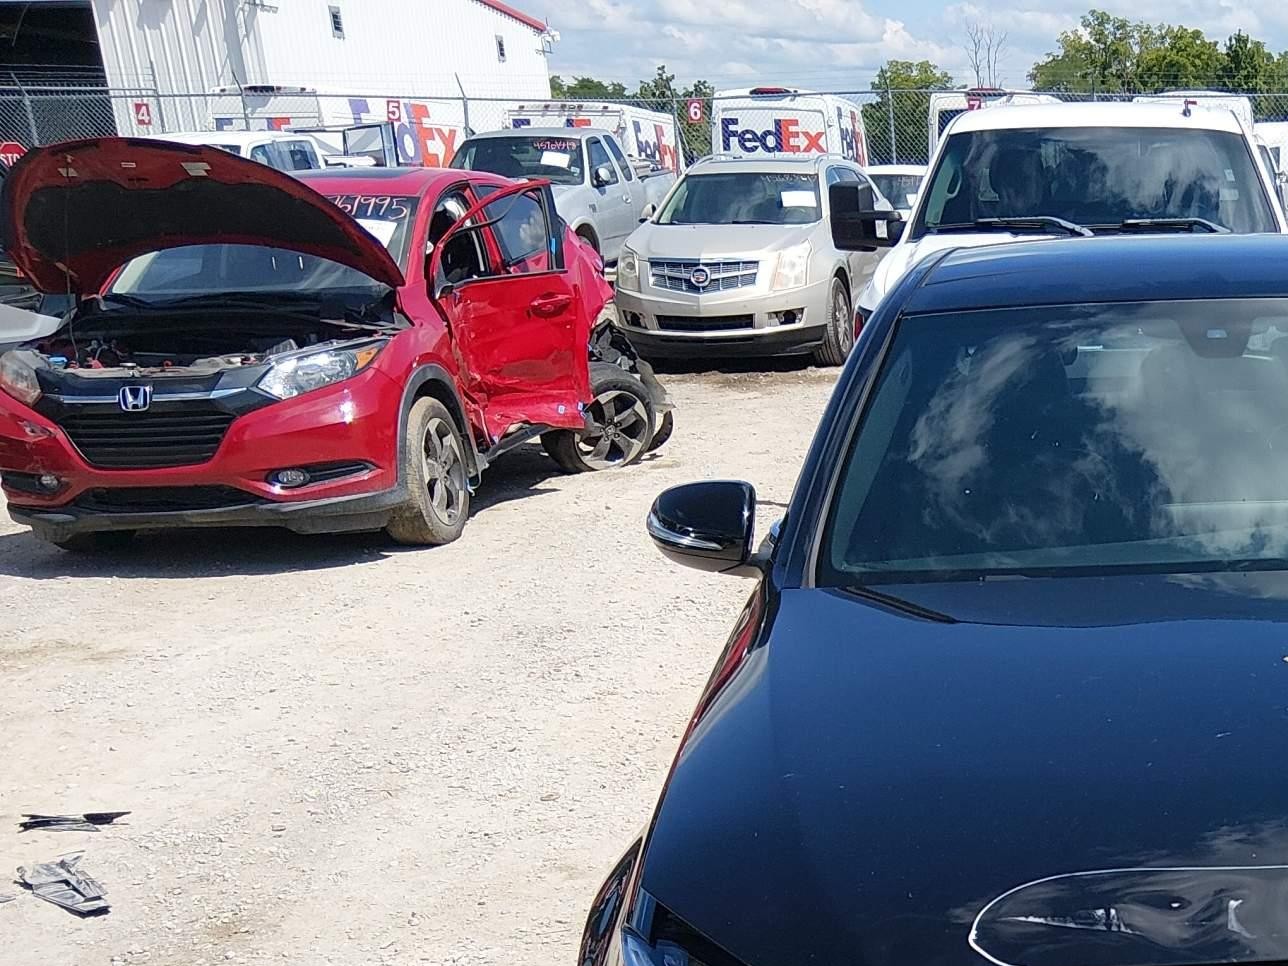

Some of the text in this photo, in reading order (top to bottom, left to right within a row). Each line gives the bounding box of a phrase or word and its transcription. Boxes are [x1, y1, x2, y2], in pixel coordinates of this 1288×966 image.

[137, 105, 150, 124] 4
[388, 102, 399, 120] 5
[689, 102, 701, 121] 6
[969, 100, 980, 110] 7
[721, 117, 828, 154] FedEx
